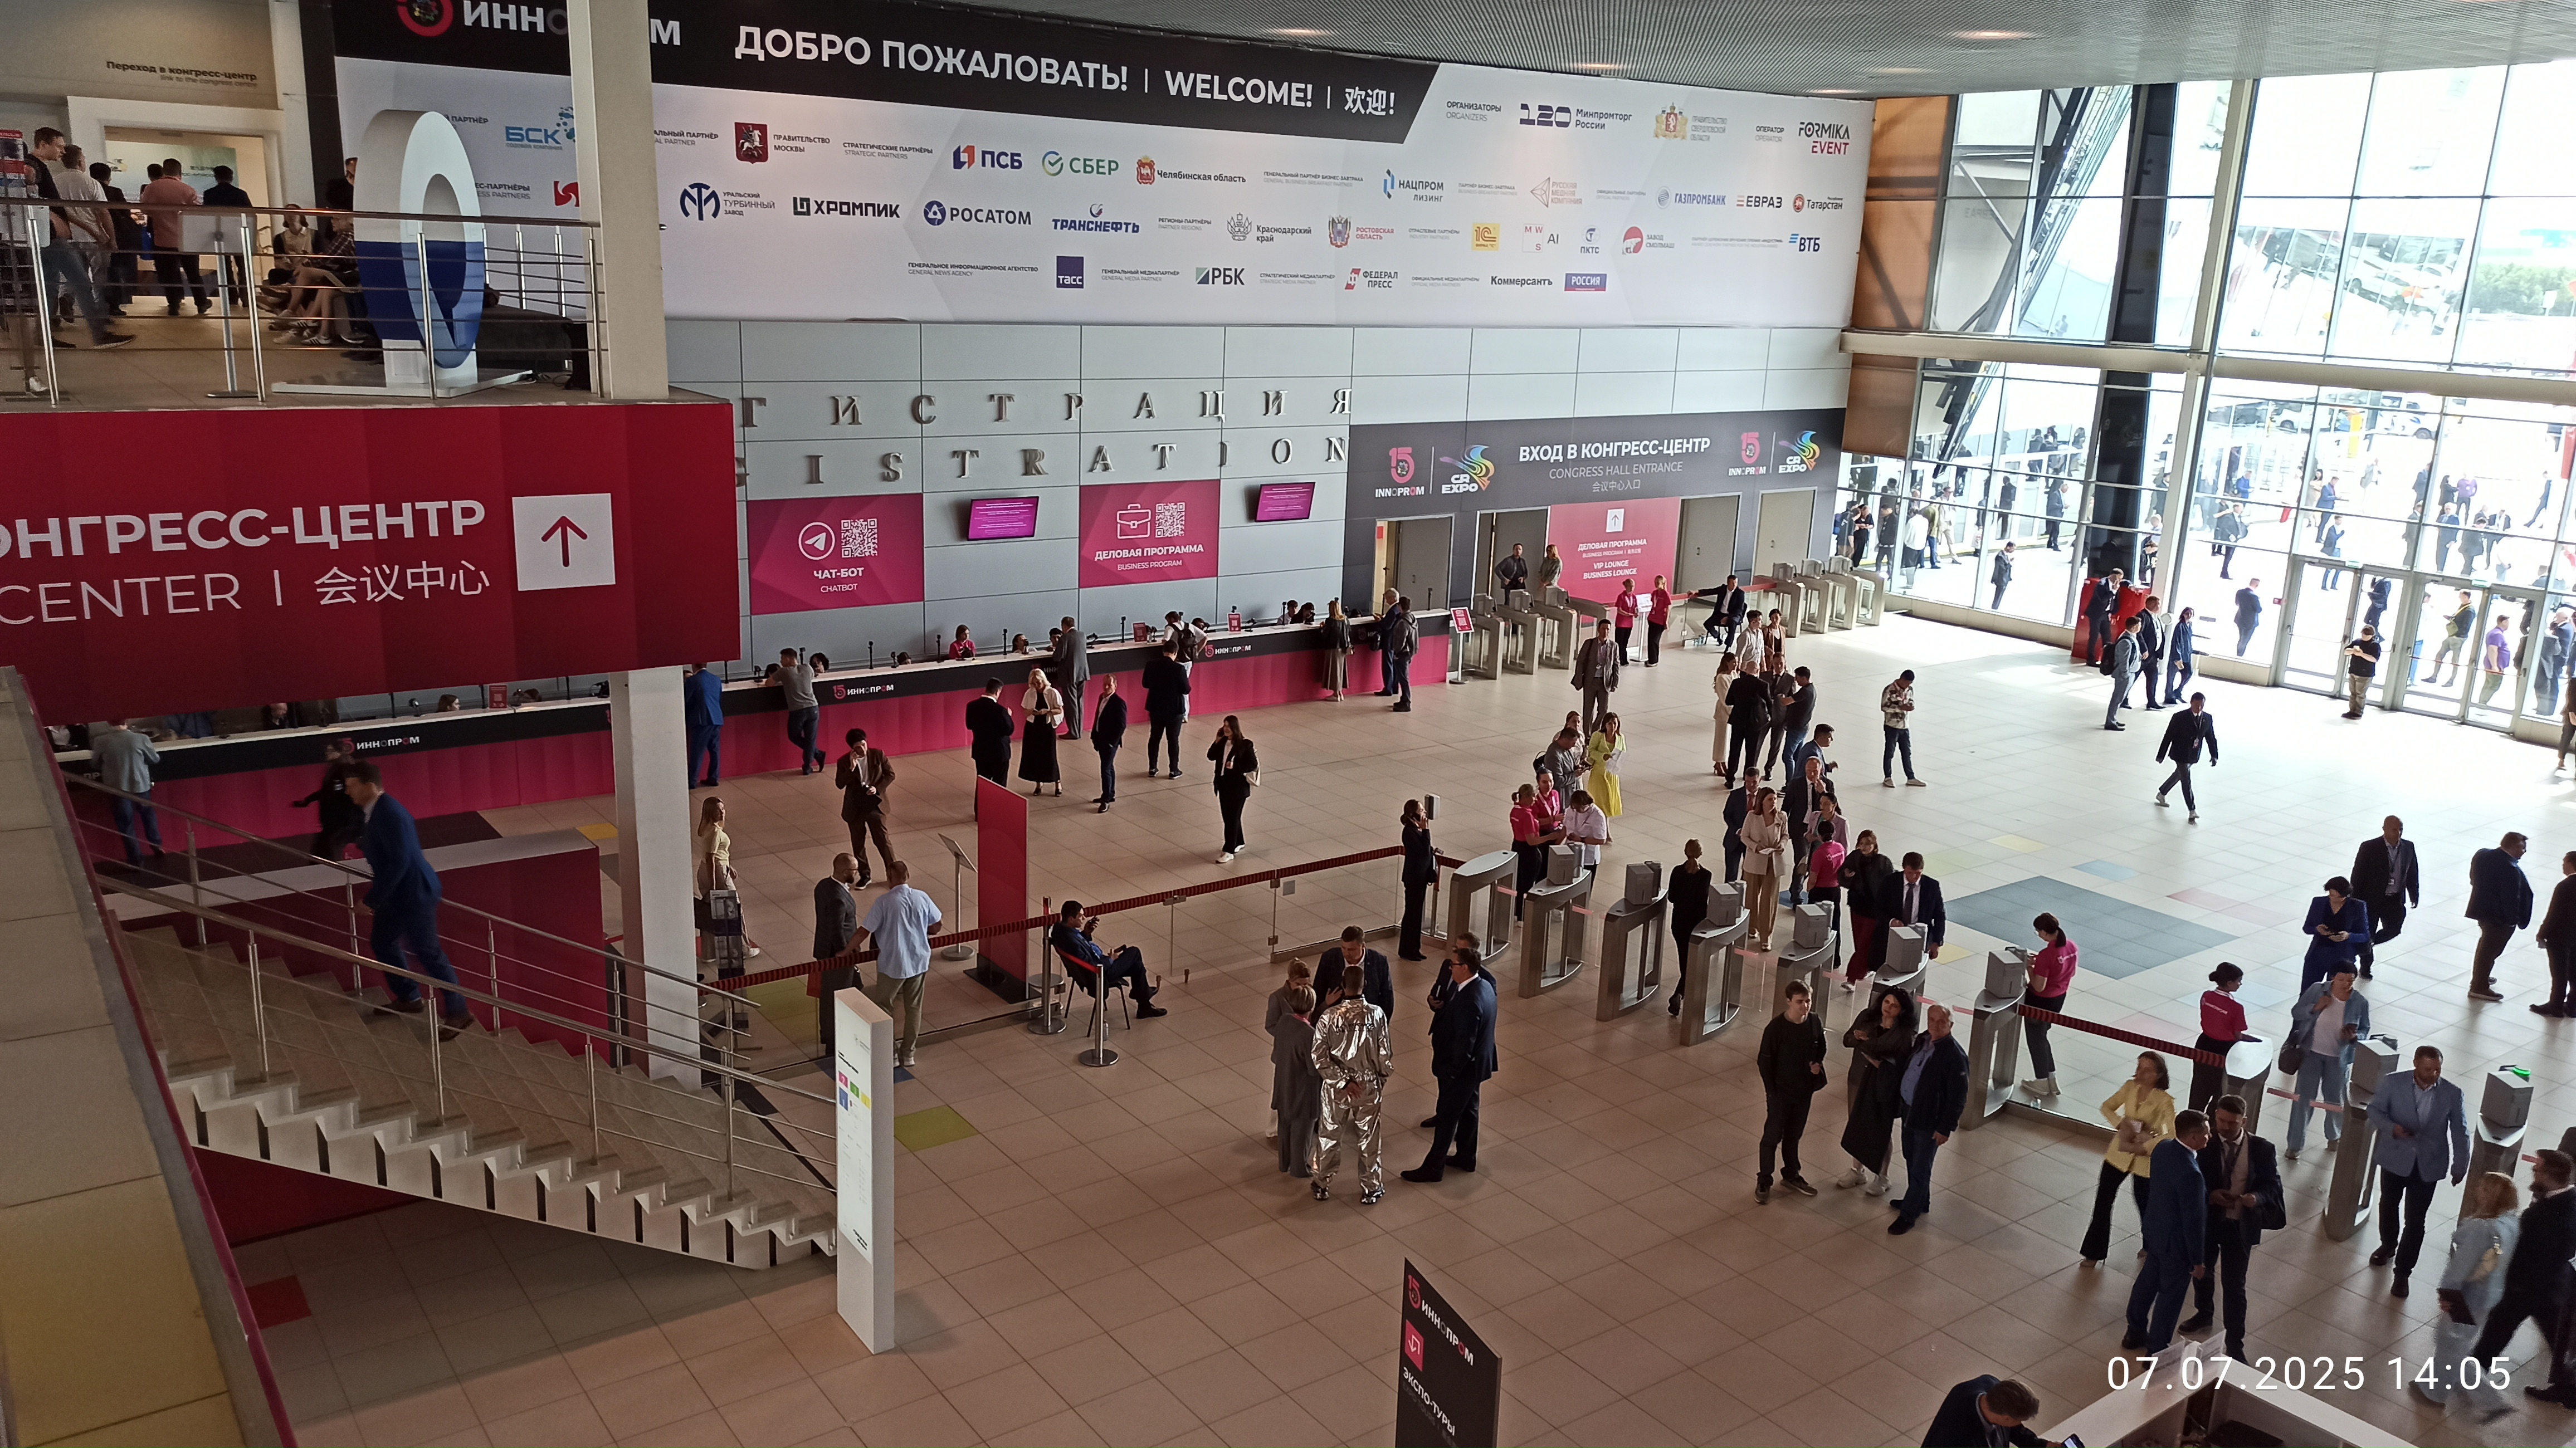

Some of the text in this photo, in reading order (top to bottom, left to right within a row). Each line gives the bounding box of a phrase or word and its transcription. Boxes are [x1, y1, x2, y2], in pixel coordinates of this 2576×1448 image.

[464, 1, 680, 46] ИННОМ
[735, 26, 1128, 91] ДОБРО ПОЖАЛОВАТЬ!
[106, 61, 157, 73] Переход
[169, 69, 256, 81] конгресс-центр
[1165, 70, 1313, 107] WELCOME!
[1344, 86, 1395, 116] 欢迎!
[1446, 101, 1501, 112] ОРГАНИЗАТОРЫ
[451, 115, 489, 124] ПАРТНЁР
[1446, 111, 1487, 121] ORGANIZERS
[1520, 103, 1572, 128] 120
[1576, 109, 1632, 122] Минпромторг
[1575, 120, 1606, 130] России
[1798, 121, 1850, 140] FORMIKA
[505, 126, 562, 145] БСК
[773, 134, 830, 144] ПРАВИТЕЛЬСТВО
[843, 142, 897, 151] СТРАТЕГИЧЕСКИЕ
[1812, 141, 1850, 155] EVENT
[982, 150, 1023, 168] ПСБ
[1069, 157, 1119, 175] СБЕР
[1158, 169, 1246, 183] Челябинская область
[475, 183, 530, 192] ЕС-ПАРТНЁРЫ
[1399, 179, 1443, 191] НАЦПРОМ
[724, 199, 775, 209] ТУРБИННЫЙ
[1413, 194, 1443, 202] ЛИЗИНГ
[1674, 193, 1726, 206] ГАЗПРОМБАНК
[1746, 195, 1782, 208] ЕВРАЗ
[814, 200, 900, 218] ХРОМПИК
[1807, 199, 1843, 211] Татарстан
[949, 207, 1032, 225] РОСАТОМ
[1052, 218, 1140, 234] ТРАНСНЕФТЬ
[1256, 225, 1311, 236] Краснодарский
[1256, 236, 1274, 244] край
[1799, 237, 1820, 252] ВТБ
[1212, 267, 1245, 285] РБК
[1363, 271, 1398, 279] ФЕДЕРАЛ
[1491, 276, 1553, 287] Коммерсантъ
[1572, 276, 1601, 286] РОССИЯ
[740, 388, 1353, 428] ГИСТРАЦИЯ
[1519, 437, 1710, 462] ВХОД В КОНГРЕСС-ЦЕНТР
[1786, 456, 1801, 464] CR
[1549, 461, 1682, 480] CONGRESS HALL ENTRANCE
[1729, 466, 1766, 476] INNOPROM
[1778, 463, 1806, 474] EXPO
[1451, 474, 1470, 483] CR
[1375, 486, 1424, 497] INNOPROM
[1442, 483, 1478, 494] EXPO
[1592, 479, 1641, 492] 会议中心入口
[0, 500, 486, 559] НГРЕСС-ЦЕНТР
[1578, 539, 1647, 552] ДЕЛОВАЯ ПРОГРАММА
[1095, 544, 1204, 561] ДЕЛОВАЯ ПРОГРАММА
[1118, 559, 1182, 570] BUSINESS PROGRAM
[1604, 560, 1629, 568] LOUNGE
[814, 567, 864, 579] ЧАТ-БОТ
[1583, 568, 1637, 579] BUSINESS LOUNGE
[314, 559, 490, 606] 会议中心
[821, 584, 858, 593] CHATBOT
[1215, 645, 1251, 654] ИННОПРОМ
[847, 684, 894, 695] ИННОПРОМ
[357, 736, 419, 750] ИННОПРОМ
[1422, 1299, 1474, 1366] ИННОПРОМ
[1403, 1366, 1455, 1436] ЭКСПО-ТУРЫ
